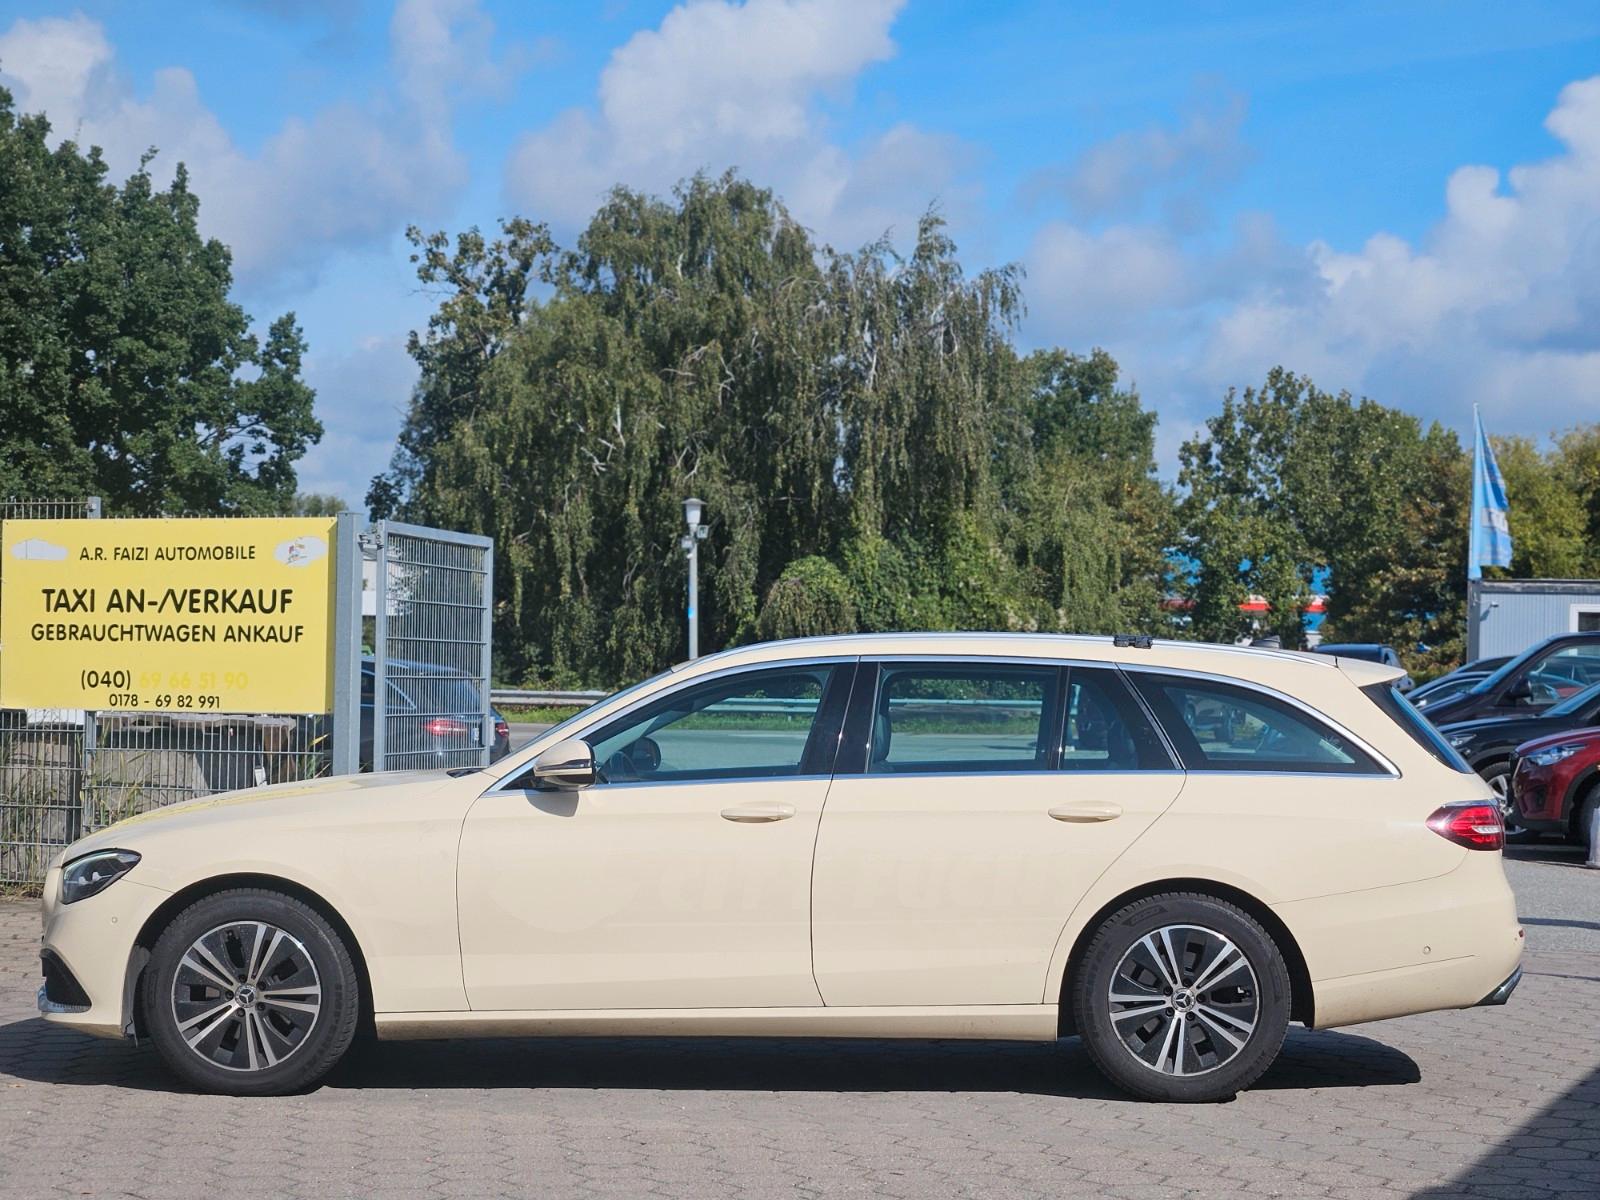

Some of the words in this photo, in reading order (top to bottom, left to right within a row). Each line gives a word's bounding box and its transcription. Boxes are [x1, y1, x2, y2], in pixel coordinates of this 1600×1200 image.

[79, 546, 107, 561] A.R.
[113, 546, 149, 561] FAIZI
[154, 545, 256, 561] AUTOMOBILE
[41, 588, 95, 613] TAXI
[106, 588, 293, 614] AN-/VERKAUF
[31, 623, 216, 643] GEBRAUCHTWAGEN
[223, 624, 304, 644] ANKAUF
[80, 669, 132, 691] (040)
[109, 693, 139, 708] 0178
[155, 694, 172, 708] 69
[177, 694, 193, 708] 82
[198, 695, 220, 709] 991
